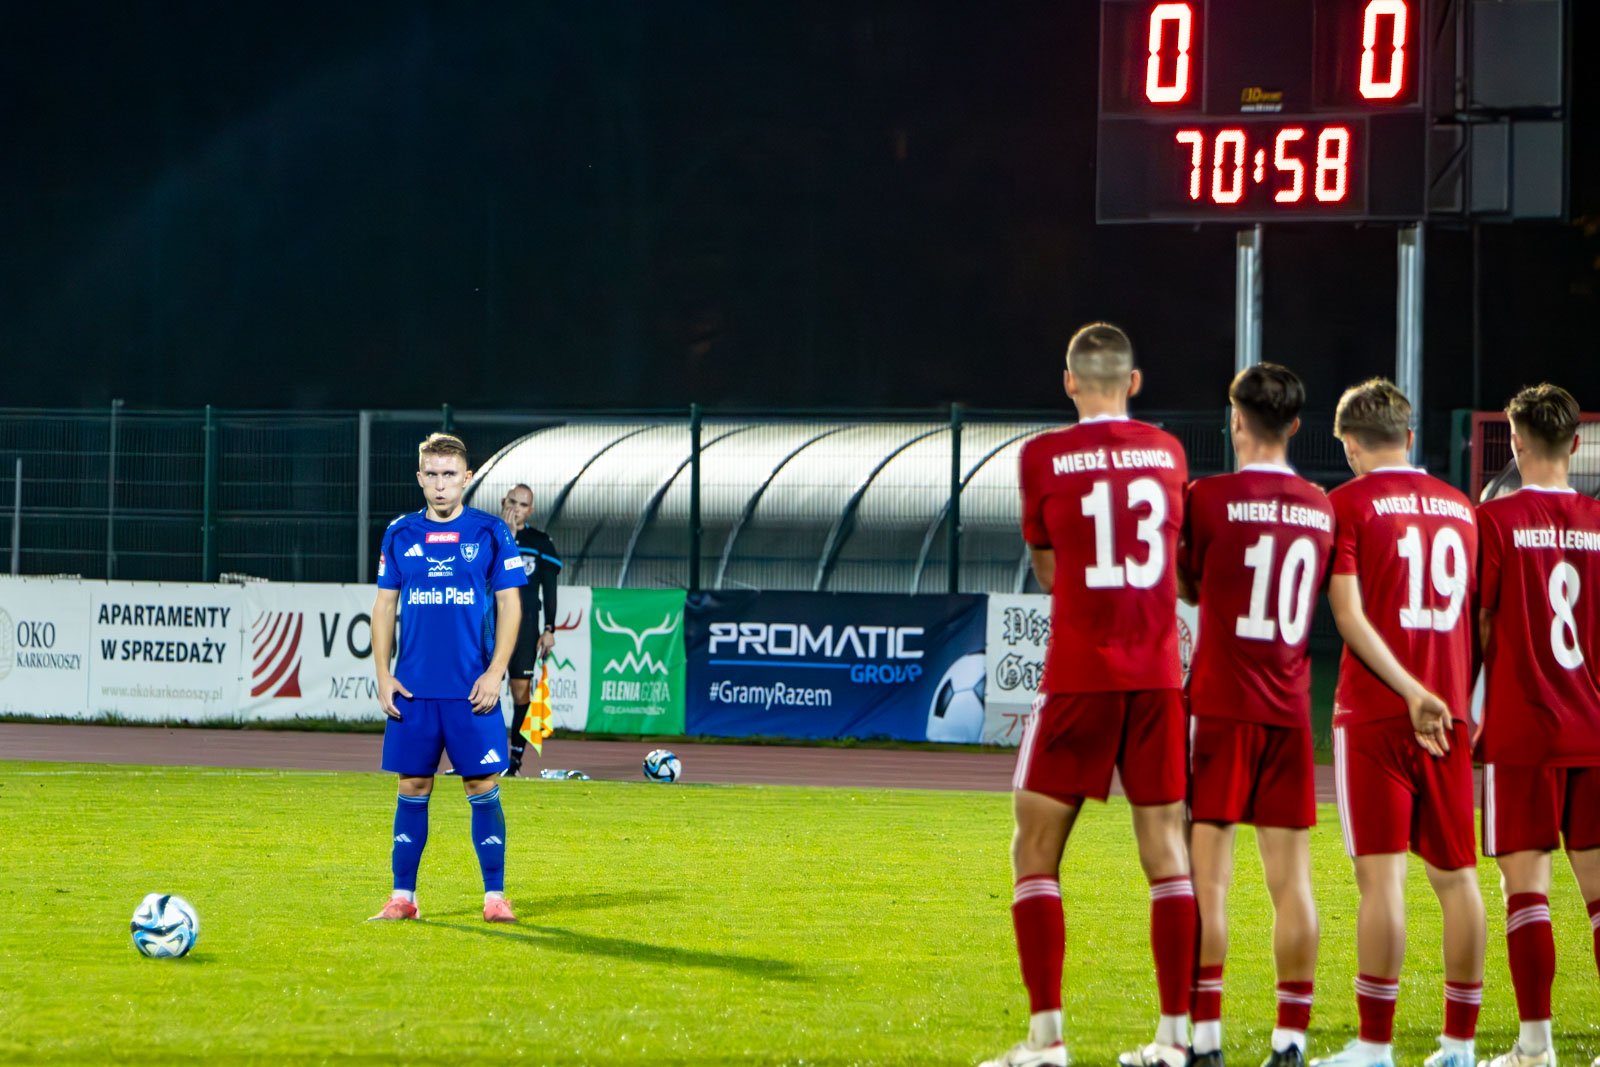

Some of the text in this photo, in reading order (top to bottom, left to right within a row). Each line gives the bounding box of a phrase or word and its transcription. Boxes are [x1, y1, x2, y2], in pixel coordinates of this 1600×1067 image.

[1145, 3, 1192, 103] 0
[1359, 0, 1407, 99] 0
[1176, 127, 1350, 203] 70:58
[1052, 449, 1175, 475] MIEDŹ LEGNICA
[1227, 501, 1332, 533] MIEDŹ LEGNICA
[1372, 494, 1474, 525] MIEDŹ LEGNICA
[1081, 478, 1166, 589] 13
[1513, 525, 1557, 549] MIEDŹ
[1235, 535, 1317, 646] 10
[1397, 526, 1468, 632] 19
[408, 587, 475, 605] Jelenia Plast
[98, 603, 231, 628] APARTAMENTY
[1548, 561, 1584, 670] 8
[17, 620, 56, 648] OKO
[708, 622, 924, 659] PROMATIC
[16, 651, 81, 671] KARKONOSZY
[101, 637, 226, 664] W SPRZEDAŻY
[329, 676, 379, 699] NETW
[851, 664, 923, 685] GROUP
[101, 684, 223, 703] www.okokarkonoszy.pl
[601, 681, 640, 701] JELENIA
[709, 680, 832, 710] #GramyRazem
